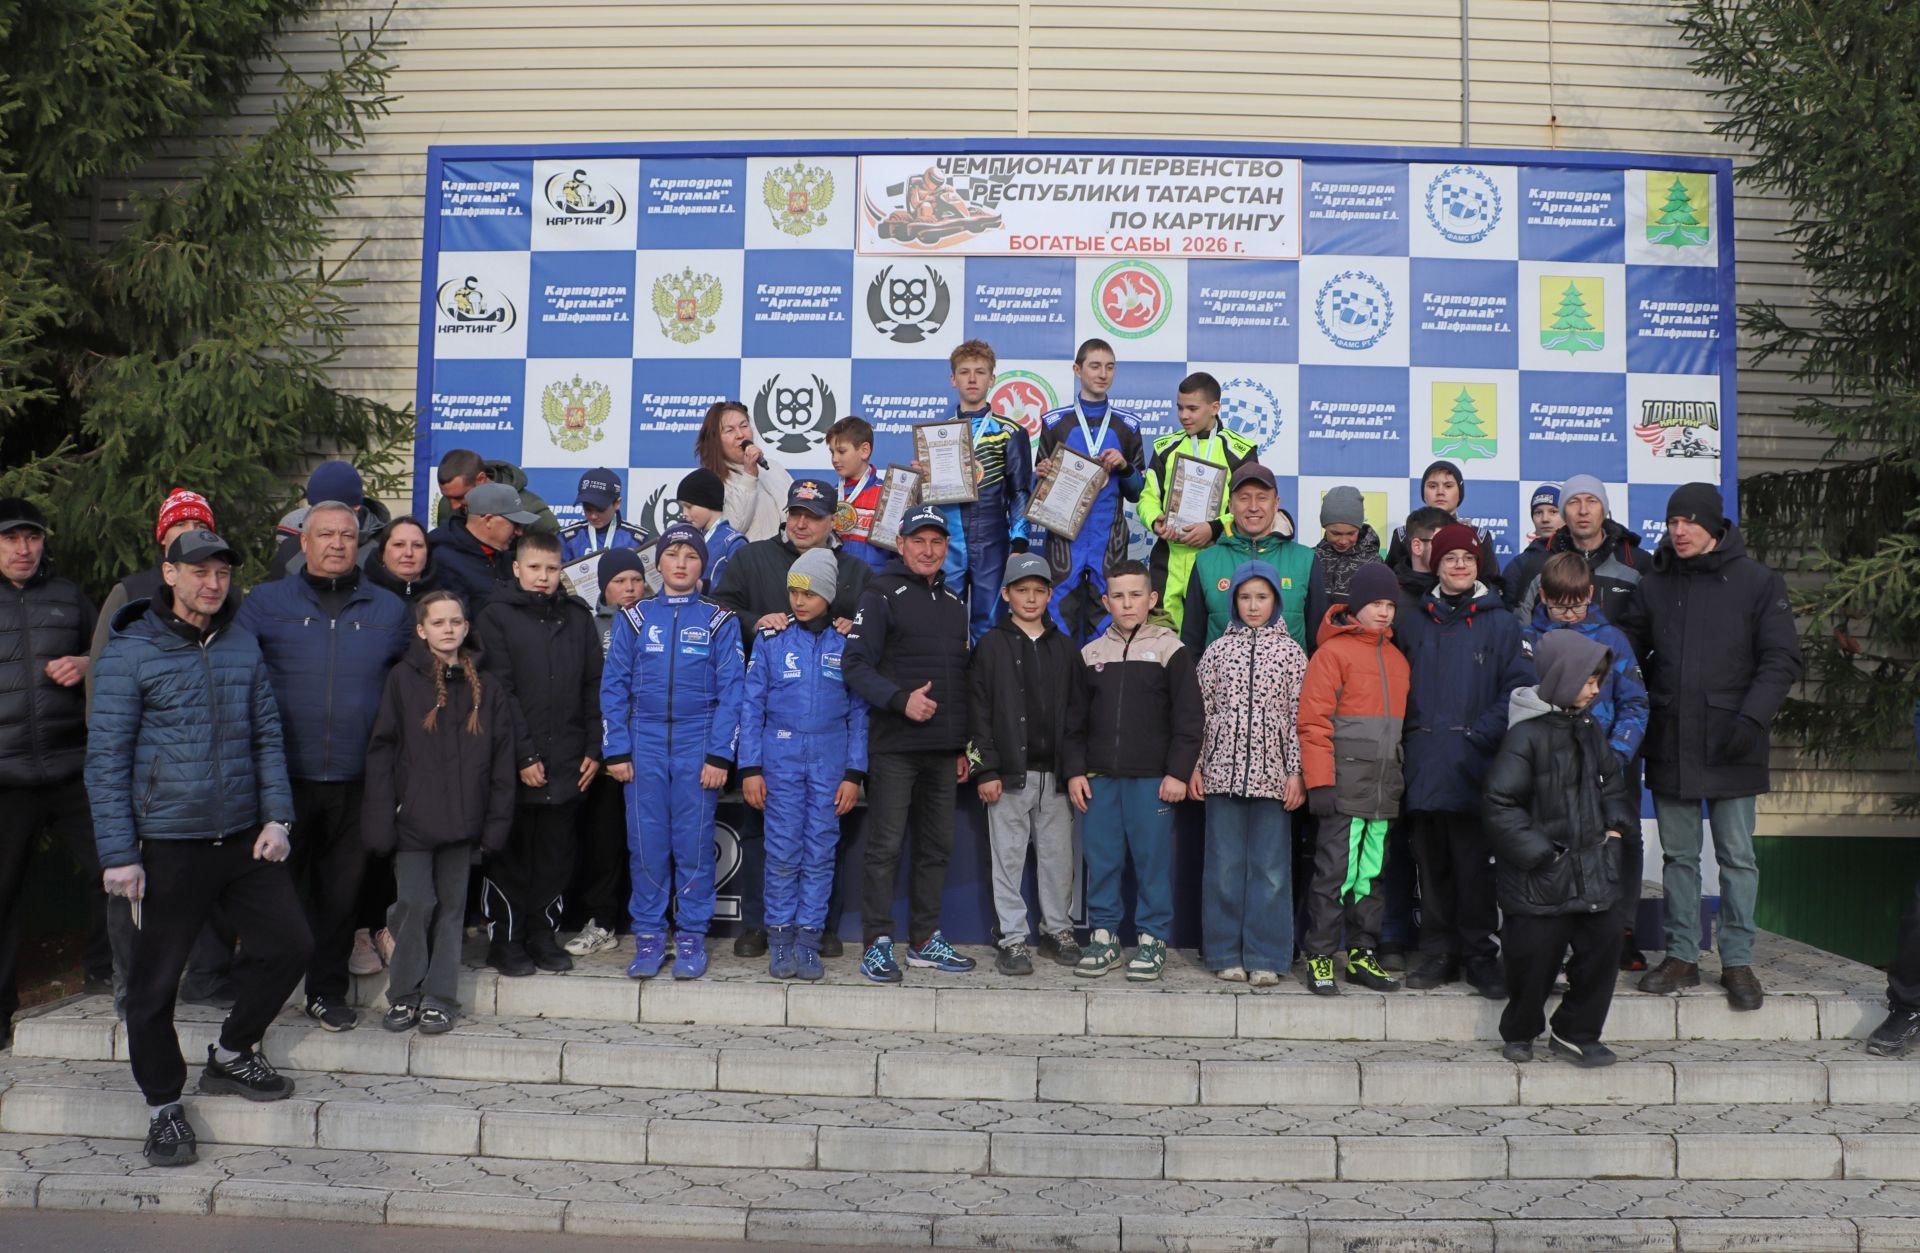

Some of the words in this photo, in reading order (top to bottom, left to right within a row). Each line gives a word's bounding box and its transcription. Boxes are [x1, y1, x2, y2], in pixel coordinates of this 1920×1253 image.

[936, 157, 1093, 175] ЧЕМПИОНАТ
[1097, 158, 1115, 175] И
[1120, 158, 1284, 178] ПЕРВЕНСТВО
[442, 181, 520, 192] Картодром
[649, 178, 733, 190] Картодром
[1310, 182, 1396, 195] Картодром
[972, 184, 1140, 203] РЕСПУБЛИКИ
[1146, 185, 1284, 205] ТАТАРСТАН
[1528, 188, 1612, 202] Картодром
[546, 217, 607, 226] КАРТИНГ
[1109, 212, 1147, 230] ПО
[1152, 212, 1285, 232] КАРТИНГУ
[1009, 235, 1105, 251] БОГАТЫЕ
[1110, 236, 1171, 252] САБЫ
[1182, 237, 1228, 253] 2026
[1234, 239, 1246, 253] г.
[544, 286, 627, 297] Картодром
[757, 284, 842, 296] Картодром
[976, 285, 1062, 298] Картодром
[1200, 287, 1286, 301] Картодром
[1423, 293, 1507, 307] Картодром
[1639, 300, 1720, 314] Картодром
[438, 324, 498, 334] КАРТИНГ
[431, 393, 511, 405] Картодром
[862, 394, 948, 407] Картодром
[1310, 401, 1395, 414] Картодром
[1530, 402, 1614, 417] Картодром
[1642, 400, 1718, 430] TORNADO
[1660, 418, 1702, 428] КАРТИНГ
